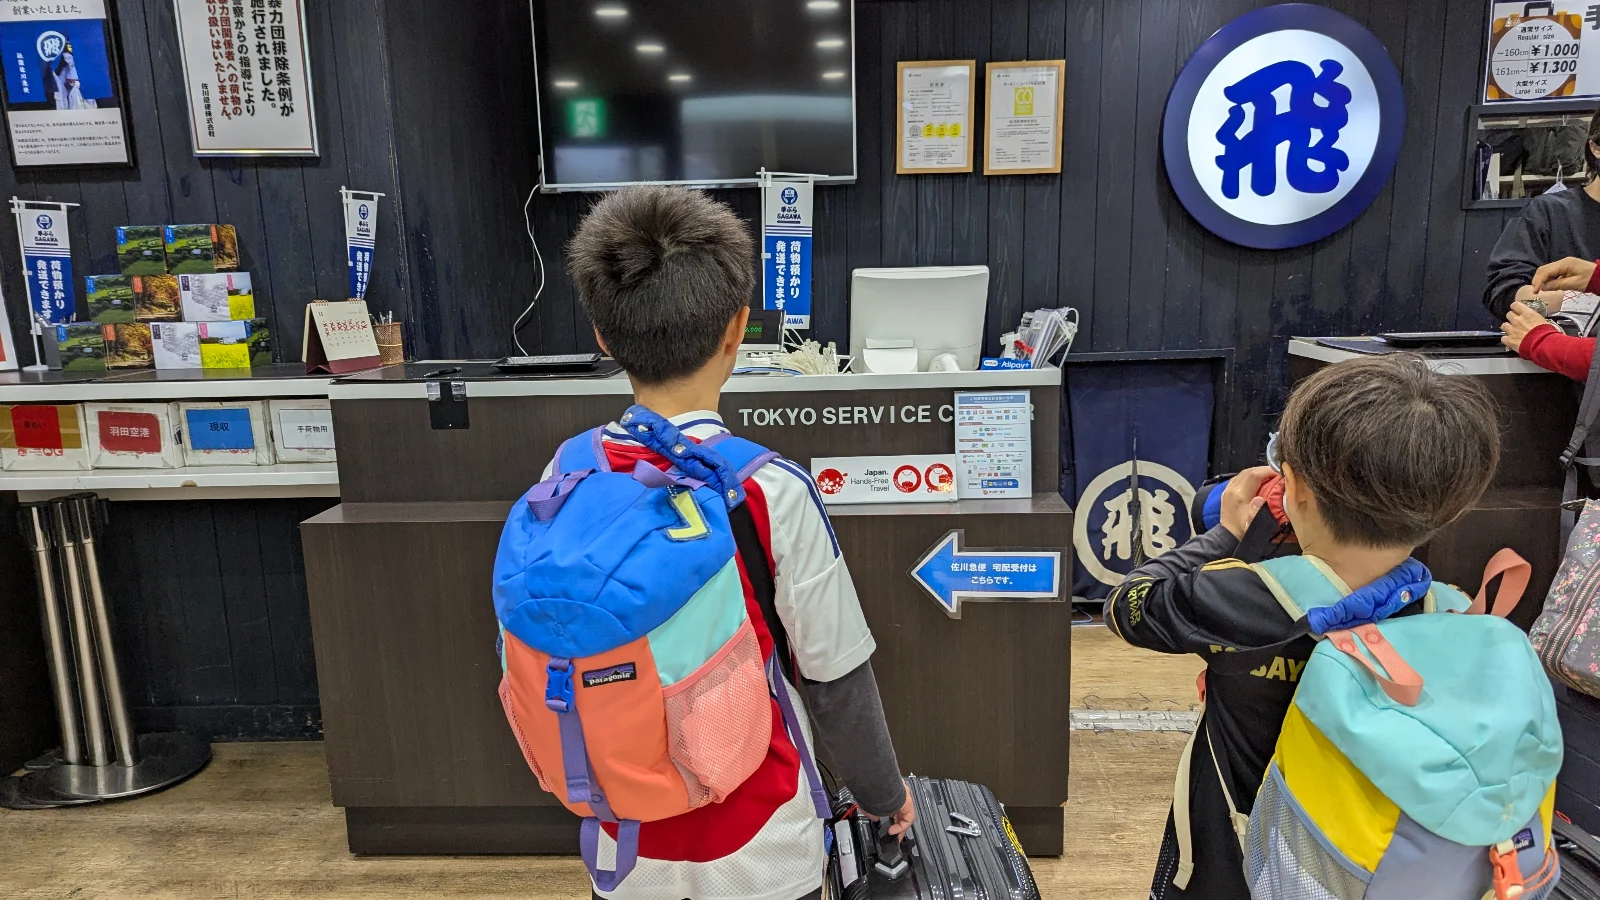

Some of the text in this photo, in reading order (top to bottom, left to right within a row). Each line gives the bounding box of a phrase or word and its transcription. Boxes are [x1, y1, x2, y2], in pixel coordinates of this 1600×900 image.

[1515, 79, 1547, 87] 大型サイズ
[775, 241, 786, 310] 発送できます
[790, 241, 801, 298] 荷物預かり
[36, 260, 53, 319] 発送できます
[50, 260, 65, 310] 荷物預かり
[738, 407, 817, 426] TOKYO
[822, 405, 931, 425] SERVICE
[109, 426, 150, 438] 羽田空港
[209, 421, 229, 433] 現収
[870, 484, 889, 492] Travel
[951, 562, 1037, 572] 佐川急便 宅配受付は
[971, 576, 1013, 585] こちらです。
[589, 672, 631, 686] patagonia
